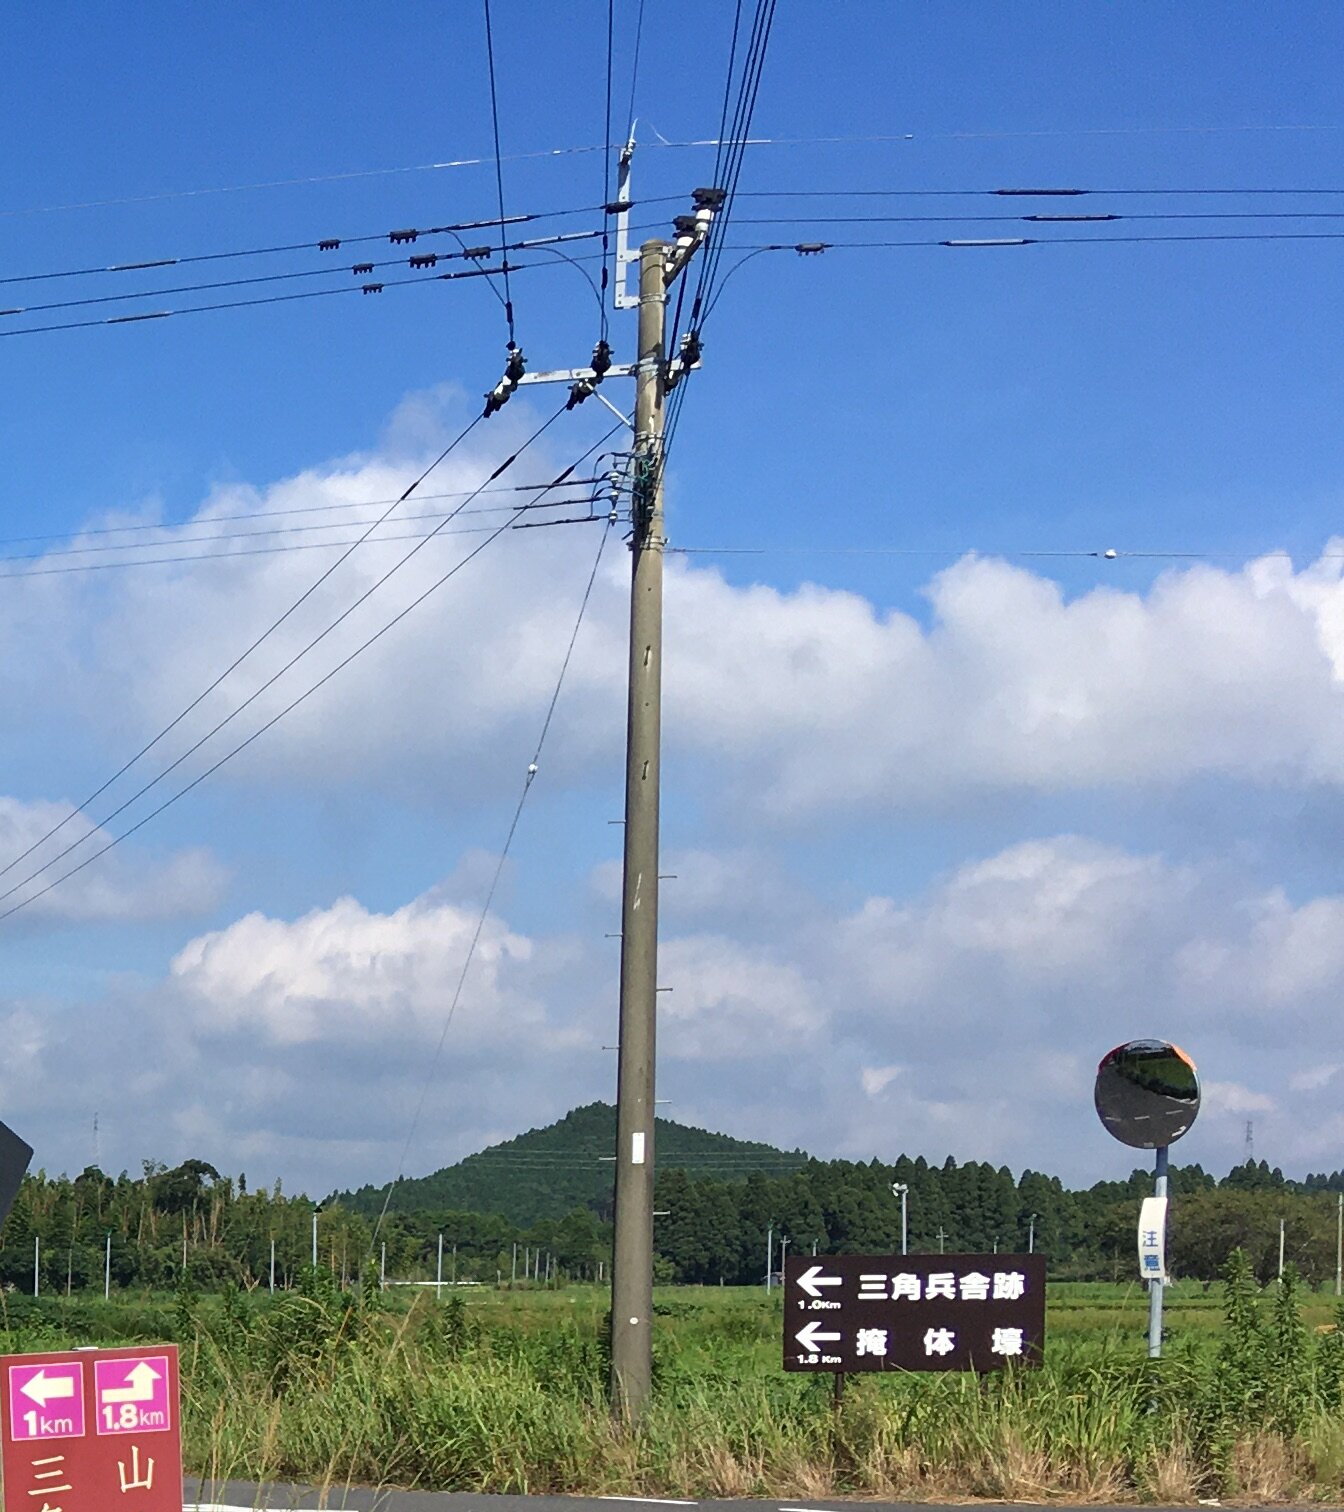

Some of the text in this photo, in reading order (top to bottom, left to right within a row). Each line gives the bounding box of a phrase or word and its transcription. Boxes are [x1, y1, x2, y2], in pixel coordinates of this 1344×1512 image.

[857, 1271, 1025, 1301] 三角兵舎跡
